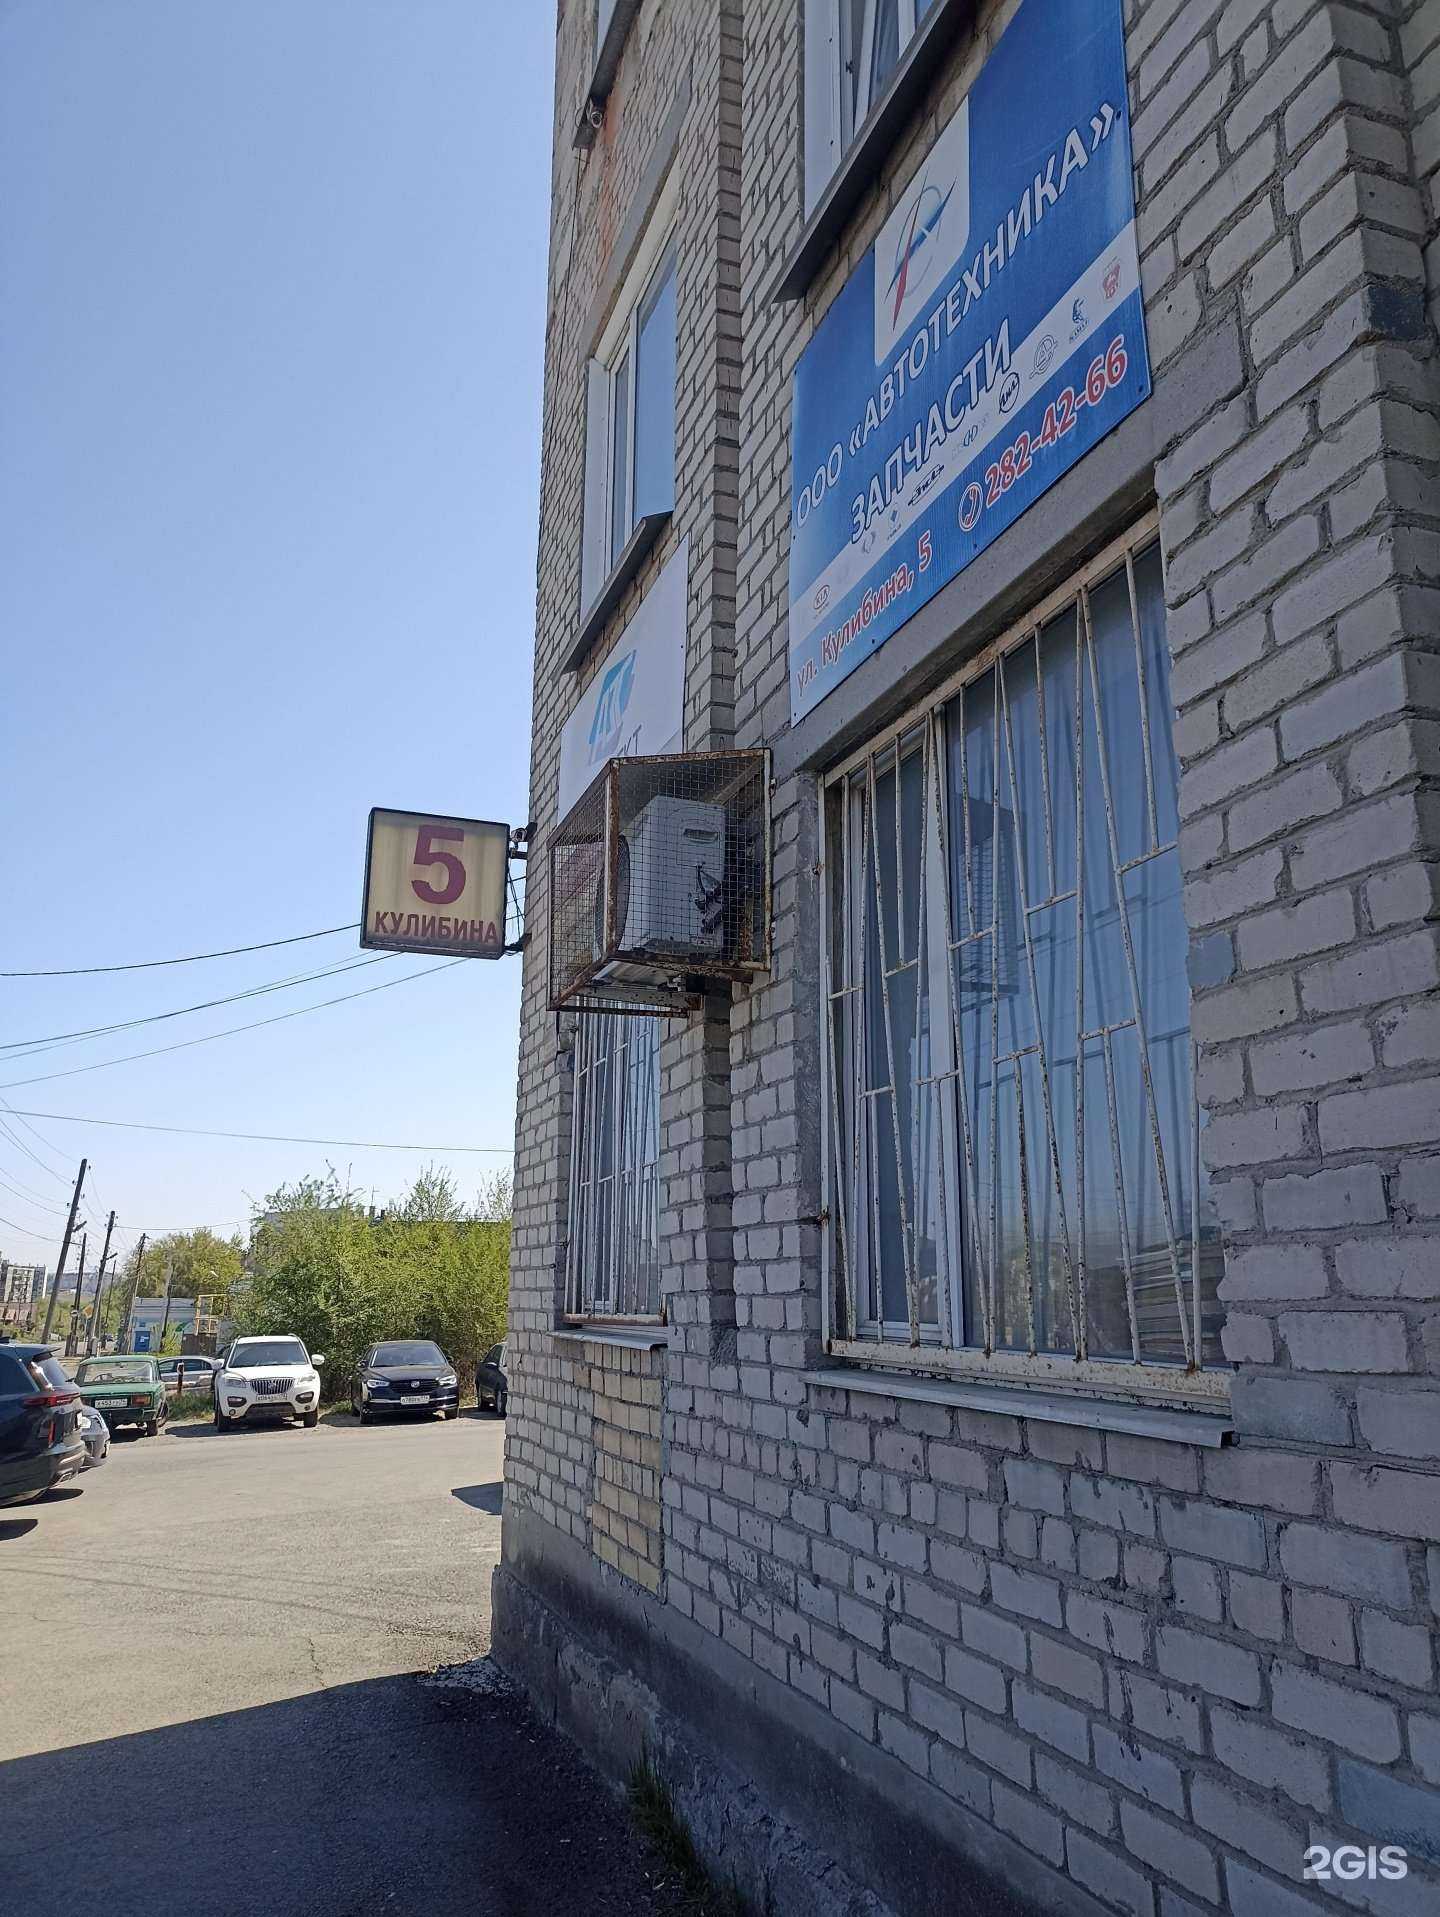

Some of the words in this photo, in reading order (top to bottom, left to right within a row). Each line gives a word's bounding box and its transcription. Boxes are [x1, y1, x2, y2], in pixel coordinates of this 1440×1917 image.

[796, 442, 843, 529] ООО
[848, 102, 1115, 459] «АВТОТЕХНИКА»
[850, 317, 1013, 545] ЗАПЧАСТИ
[983, 333, 1129, 509] 282-42-66
[795, 655, 818, 698] ул.
[820, 560, 915, 664] Кулибина,
[917, 530, 933, 575] 5
[374, 910, 499, 946] КУЛИБИНА
[411, 825, 467, 905] 5
